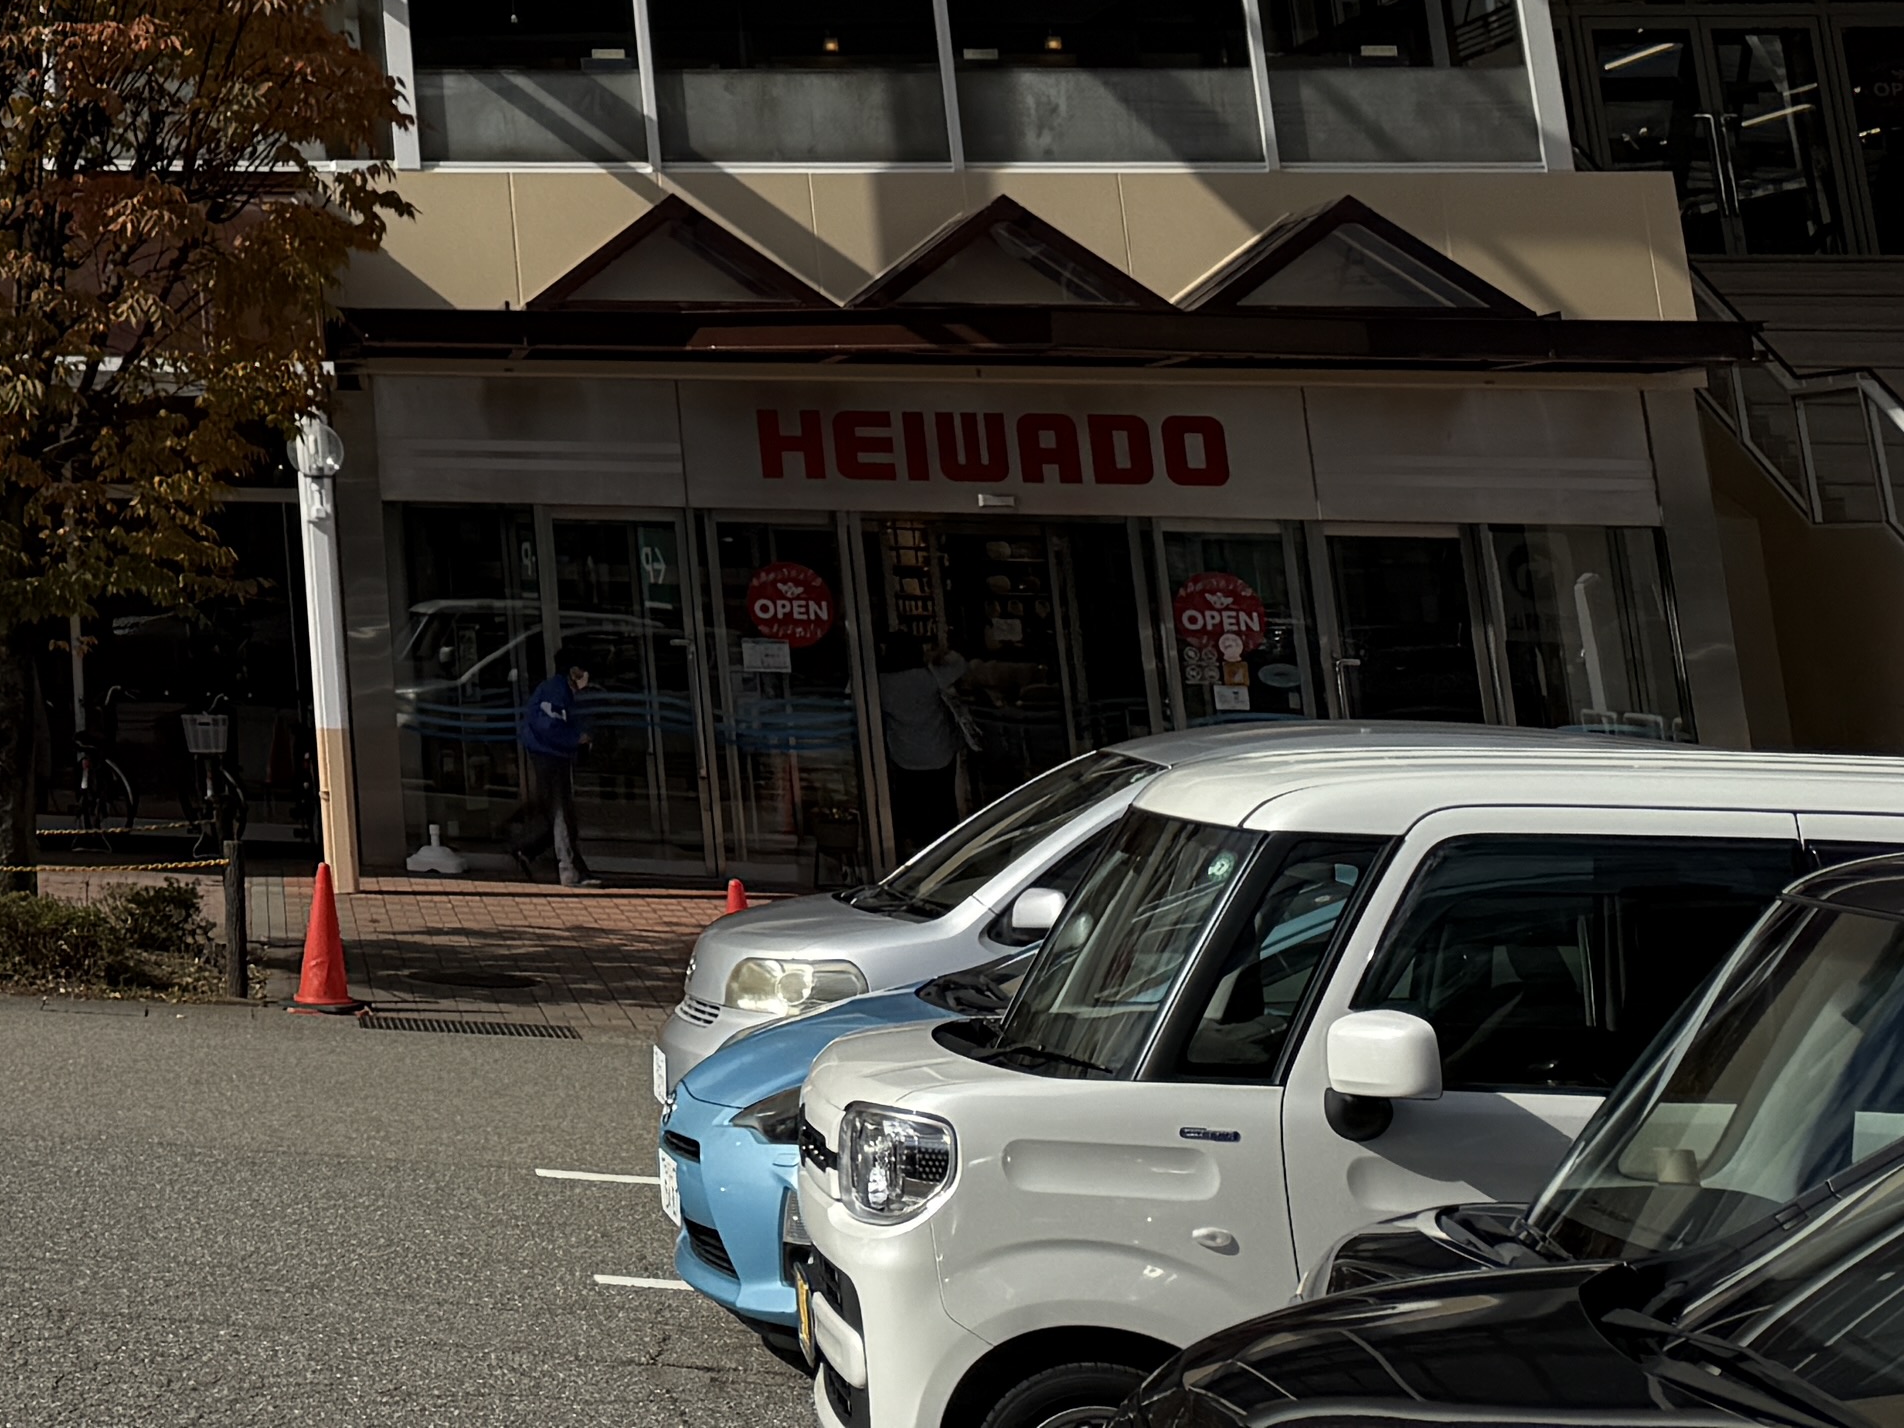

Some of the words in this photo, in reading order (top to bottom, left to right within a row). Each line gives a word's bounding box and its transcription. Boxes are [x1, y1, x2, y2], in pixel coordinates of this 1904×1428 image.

[758, 409, 1231, 486] HEIWADO
[754, 598, 829, 621] OPEN
[1181, 609, 1260, 632] OPEN
